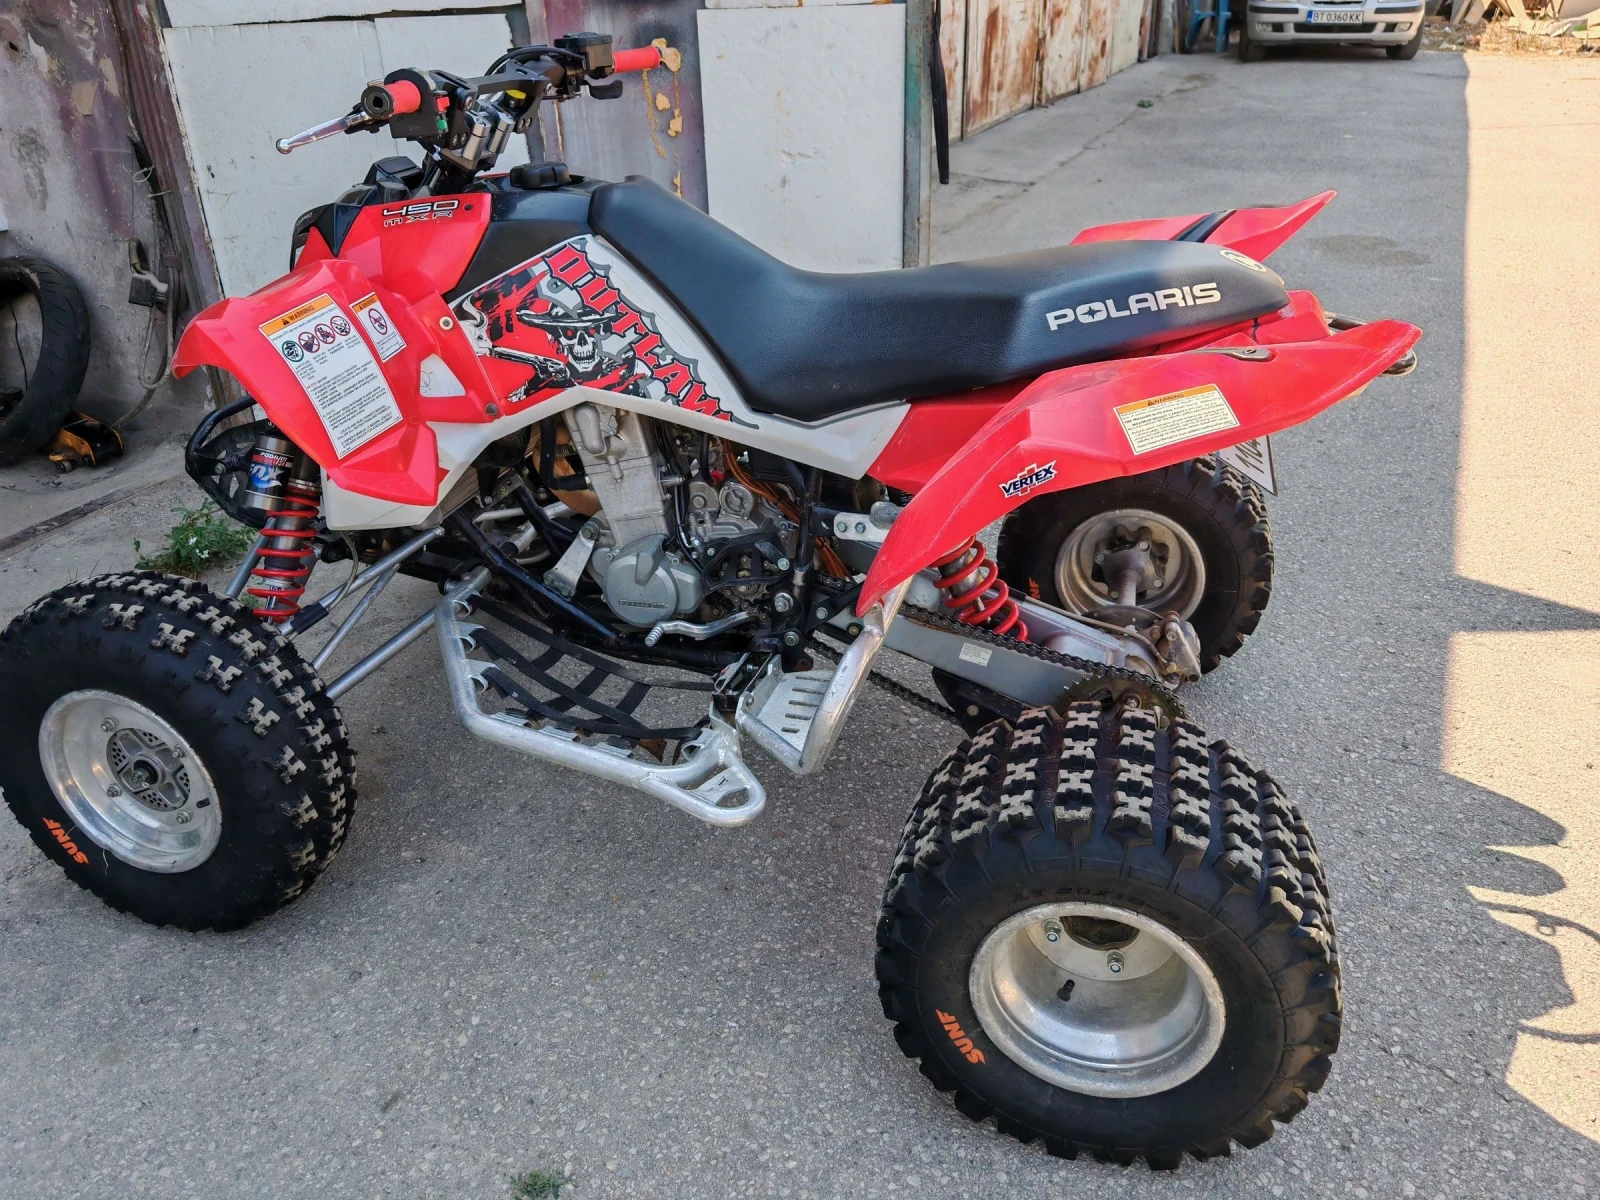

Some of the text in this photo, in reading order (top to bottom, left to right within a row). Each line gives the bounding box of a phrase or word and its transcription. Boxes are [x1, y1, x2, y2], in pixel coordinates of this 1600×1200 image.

[1326, 12, 1348, 21] 0360
[1349, 12, 1361, 21] KK
[383, 200, 459, 217] 450
[288, 305, 315, 321] WARNING
[1046, 283, 1221, 330] POLARIS
[544, 243, 733, 422] OUTLAW
[1153, 393, 1185, 405] WARNING
[1001, 464, 1054, 494] VERTEX
[42, 816, 89, 864] SUNF
[935, 1008, 986, 1065] SUNF
